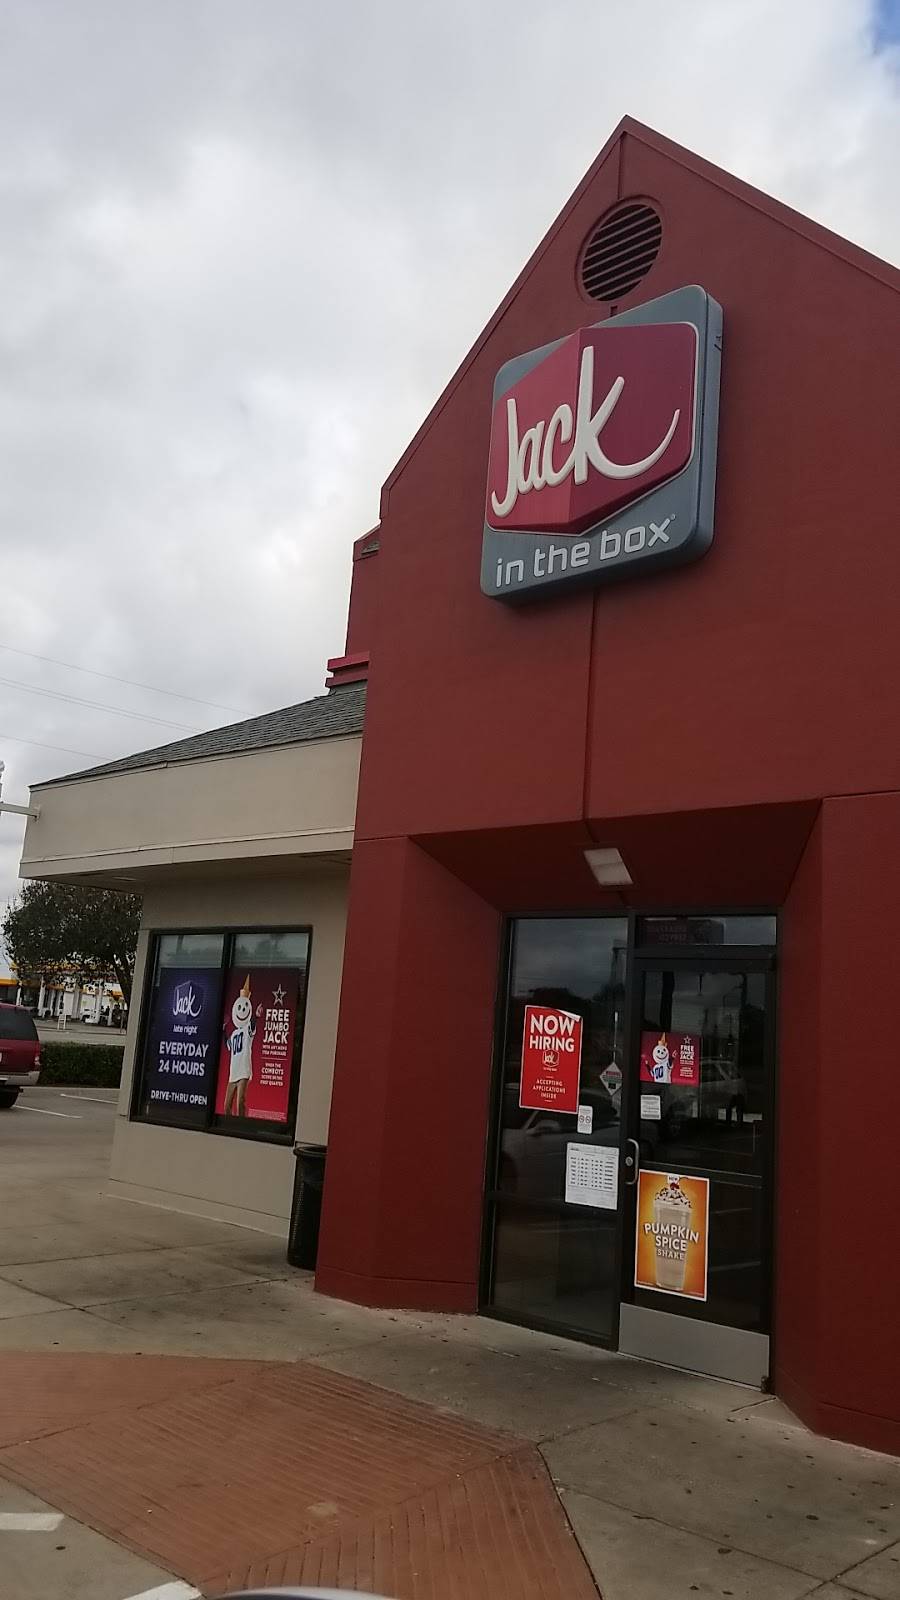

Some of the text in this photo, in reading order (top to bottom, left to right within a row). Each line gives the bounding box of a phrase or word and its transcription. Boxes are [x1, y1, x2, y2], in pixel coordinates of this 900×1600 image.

[491, 345, 681, 518] Jack
[495, 517, 672, 588] in the box
[172, 986, 201, 1017] Jack
[266, 1008, 290, 1022] FREE
[173, 1025, 198, 1035] late night
[264, 1022, 289, 1031] JUMBO
[530, 1014, 575, 1036] NOW
[263, 1031, 288, 1044] JACK
[529, 1036, 575, 1053] HIRING
[159, 1041, 209, 1058] EVERYDAY
[158, 1059, 205, 1077] 24 HOURS
[533, 1085, 566, 1094] APPLICATIONS
[536, 1078, 563, 1087] ACCEPTING
[151, 1090, 208, 1106] DRIVE-THRU OPEN
[644, 1223, 699, 1244] PUMPKIN
[655, 1235, 688, 1252] SPICE
[657, 1248, 685, 1260] SHAKE
